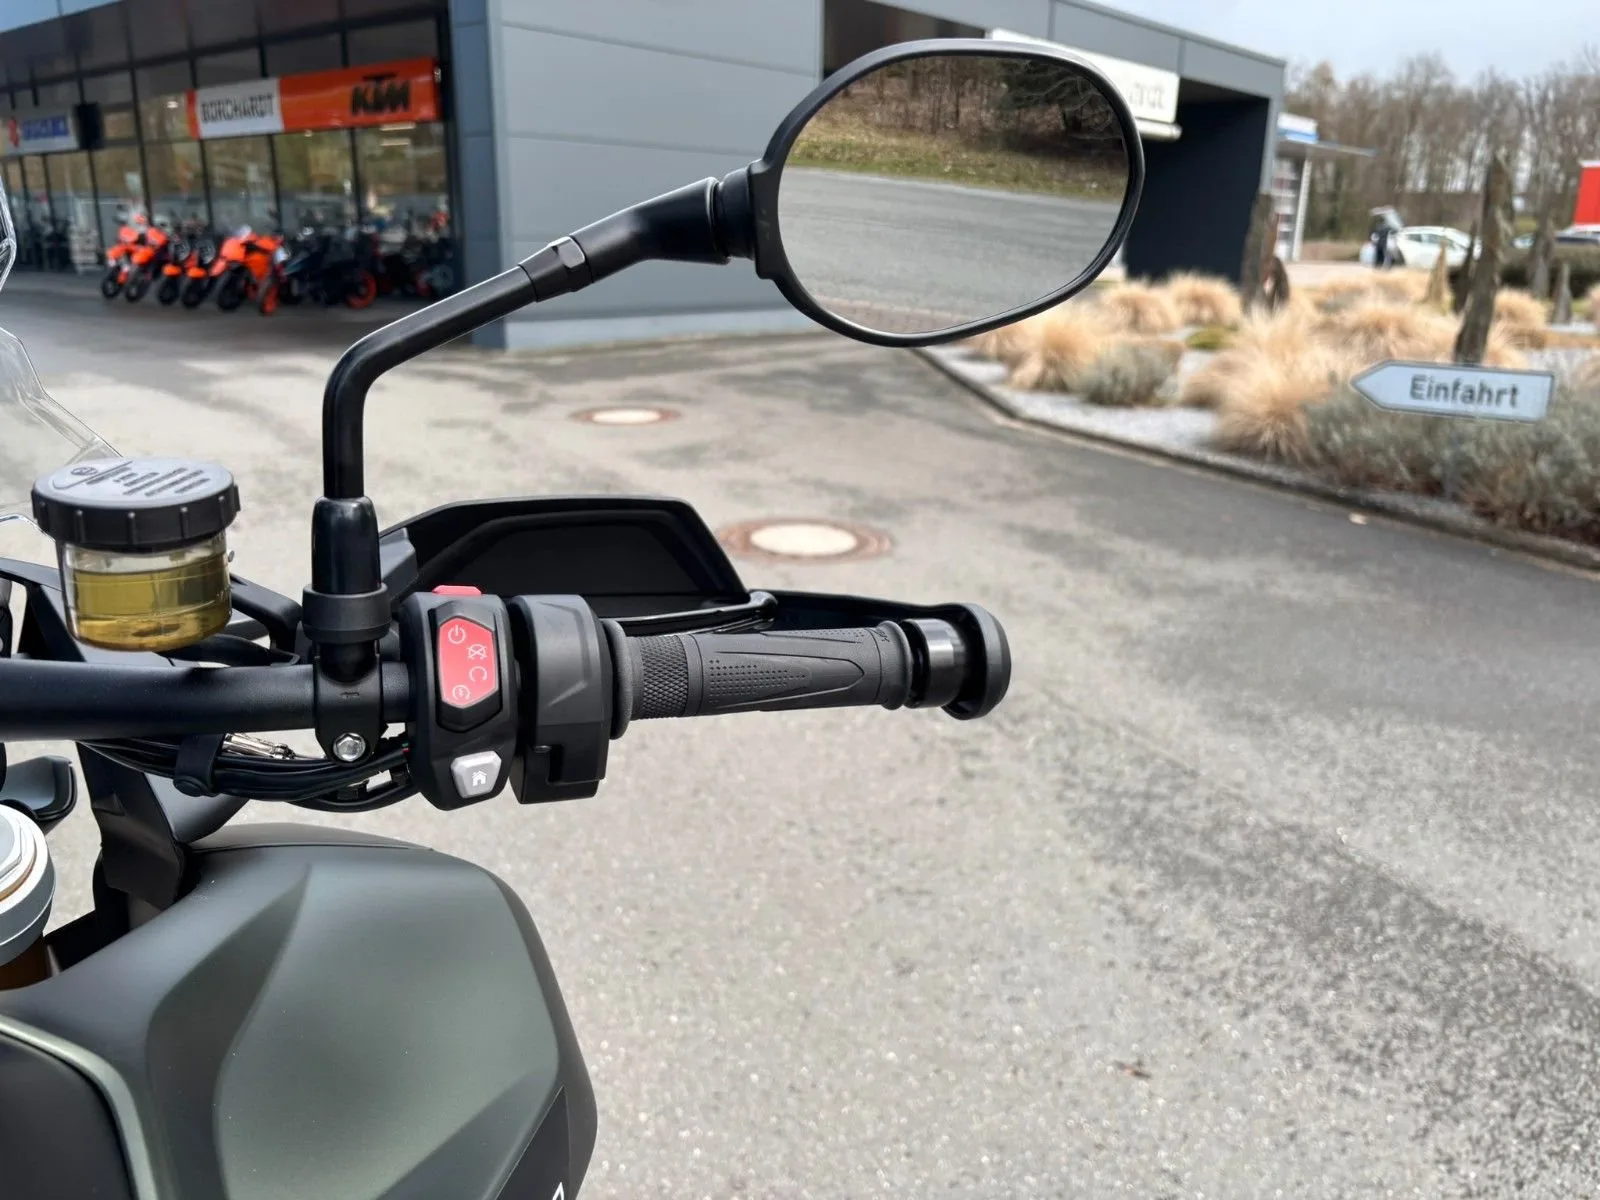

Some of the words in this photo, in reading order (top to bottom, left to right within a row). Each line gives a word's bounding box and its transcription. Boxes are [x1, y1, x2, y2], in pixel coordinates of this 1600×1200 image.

[202, 93, 273, 123] BORCHARDT
[352, 72, 410, 115] KTM
[1409, 374, 1519, 408] Einfahrt
